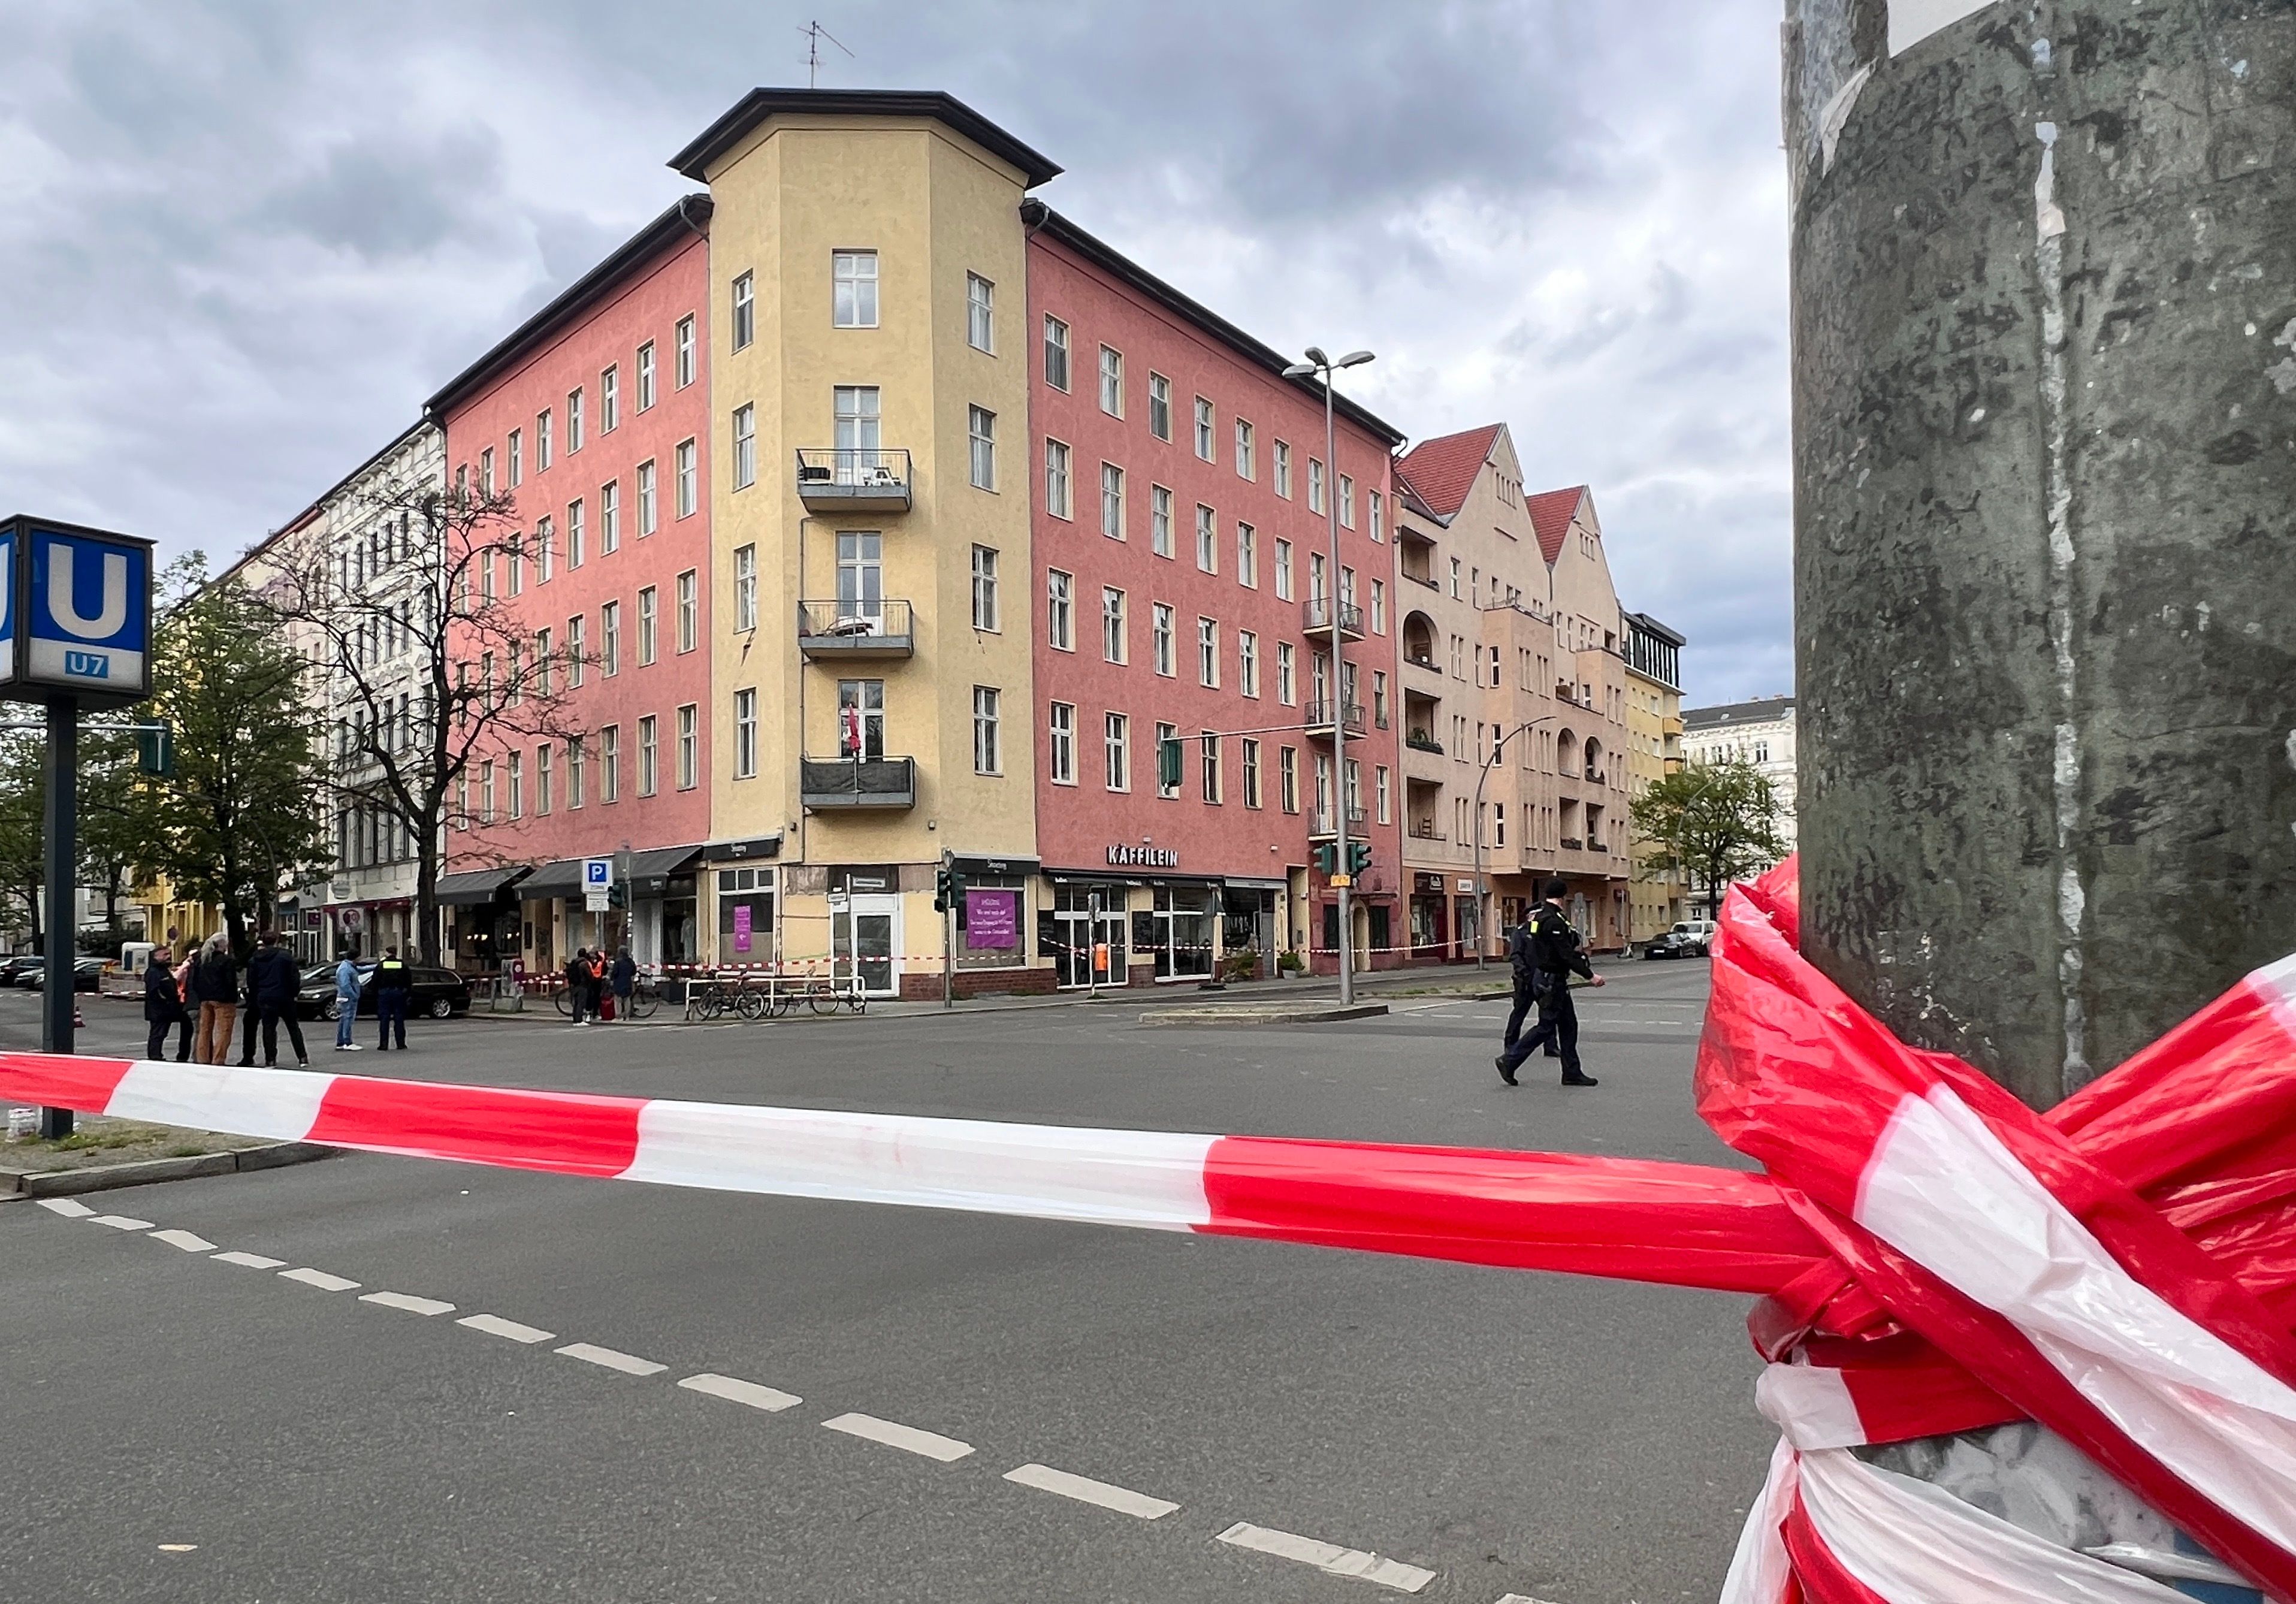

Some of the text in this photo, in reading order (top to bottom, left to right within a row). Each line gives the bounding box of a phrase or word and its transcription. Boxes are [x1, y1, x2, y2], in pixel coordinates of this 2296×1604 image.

[49, 542, 127, 639] U
[70, 654, 104, 675] U7
[591, 866, 603, 880] P
